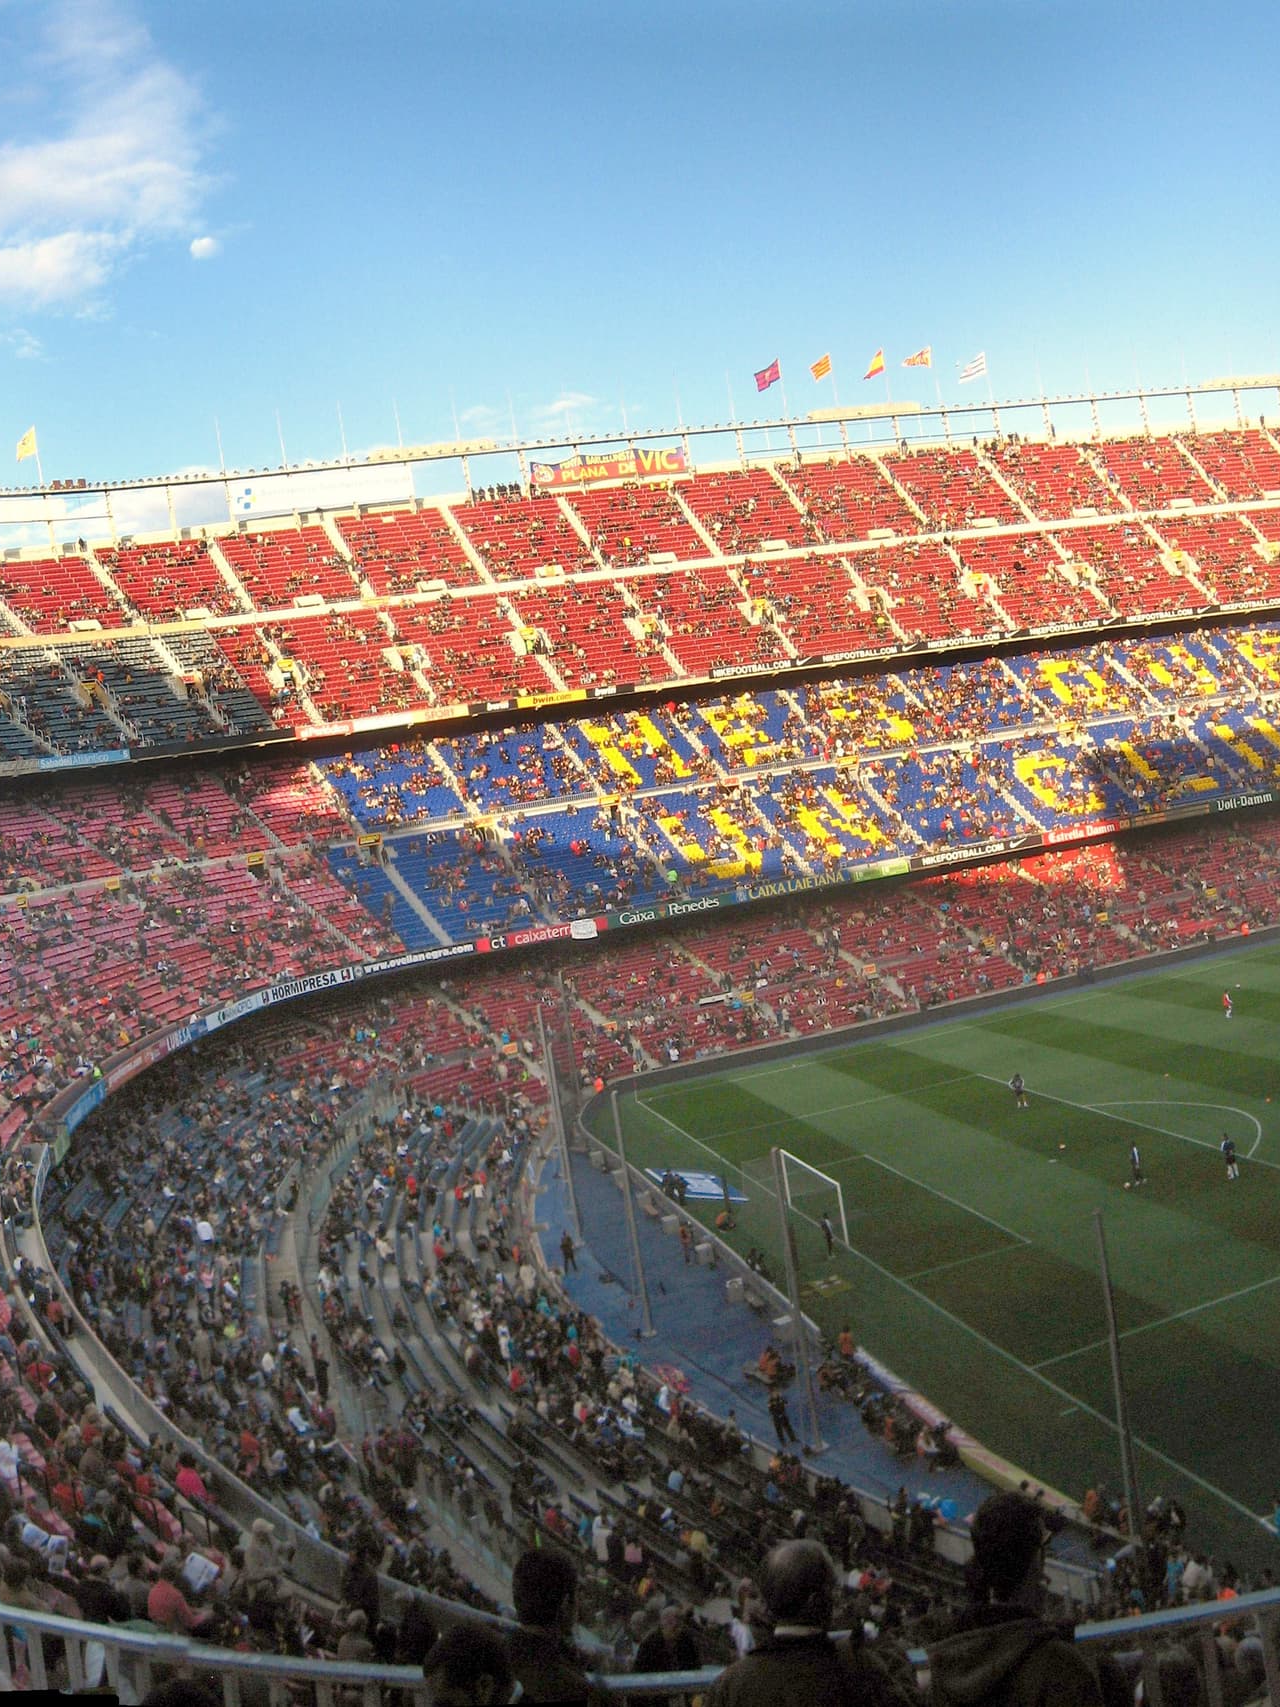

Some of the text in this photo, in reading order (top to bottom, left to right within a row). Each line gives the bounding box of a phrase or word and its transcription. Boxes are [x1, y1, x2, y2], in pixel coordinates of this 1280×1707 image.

[561, 465, 609, 482] PLANA
[638, 447, 680, 472] VIC
[927, 632, 1000, 649] NIKEFOOTBALL.COM
[822, 646, 898, 662] NIKEFOOTBALL.COM
[712, 660, 791, 678] NIKEFOOTBALL.COM
[532, 693, 572, 705] bwin.com
[594, 685, 617, 697] bwin
[1216, 791, 1273, 812] Voll-Damm
[1048, 828, 1085, 845] Estrella
[1086, 822, 1116, 839] Damm
[921, 842, 1005, 867] NIKEFOOTBALL.COM
[748, 880, 786, 900] CAIXA
[786, 870, 845, 894] LAIETANA
[619, 896, 720, 926] Caixa Penedès
[490, 934, 507, 950] ct
[271, 969, 337, 1002] HORMIPRESA
